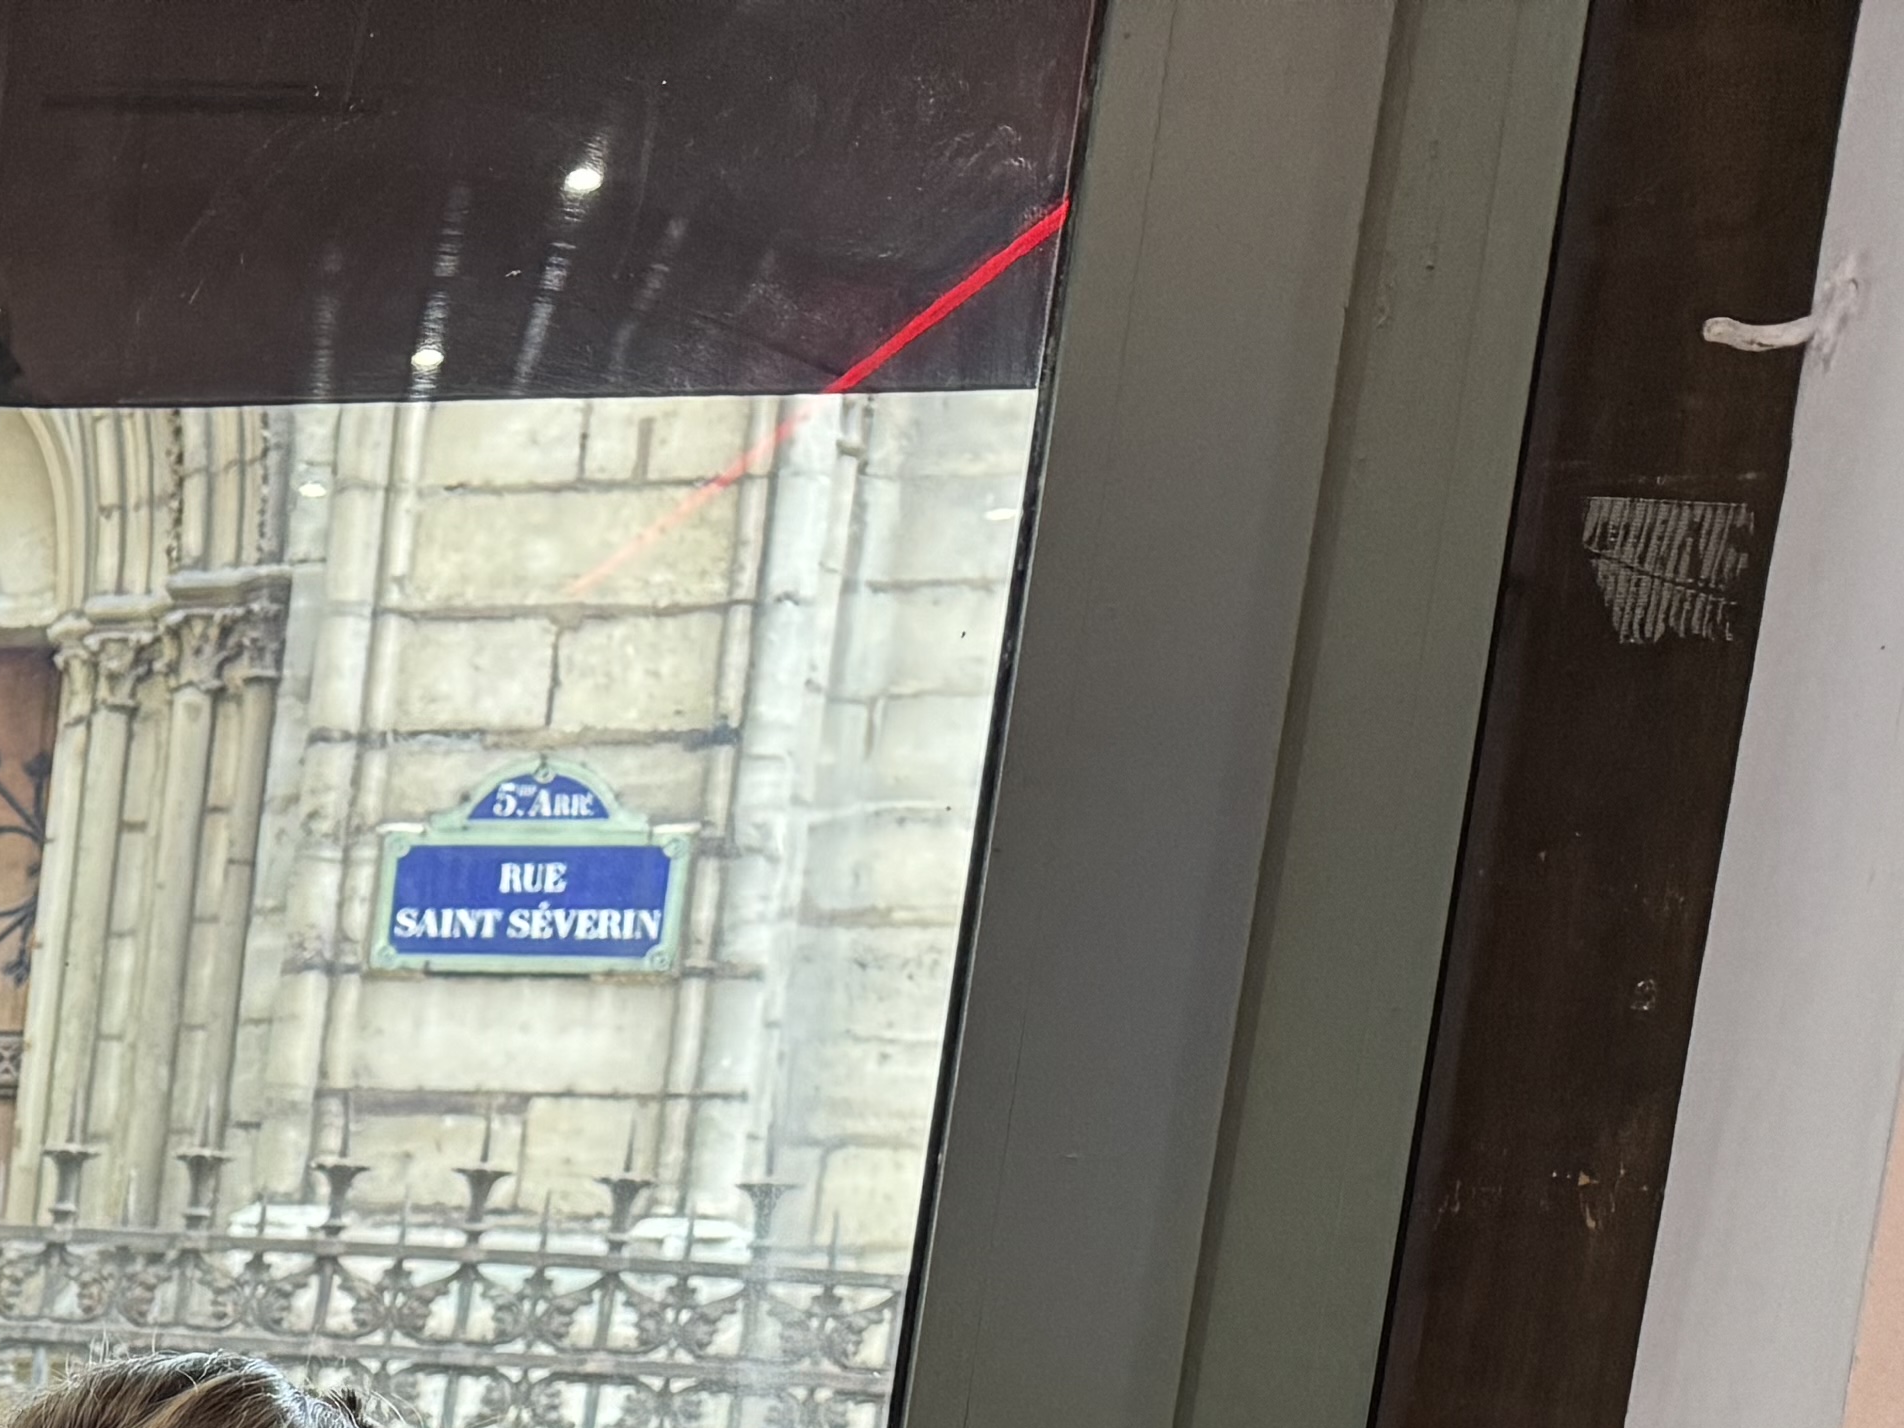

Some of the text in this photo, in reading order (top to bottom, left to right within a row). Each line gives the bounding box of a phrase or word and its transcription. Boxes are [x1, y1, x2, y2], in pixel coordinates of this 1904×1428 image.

[498, 862, 567, 894] RUE
[394, 901, 662, 941] SAINT SÉVERIN
